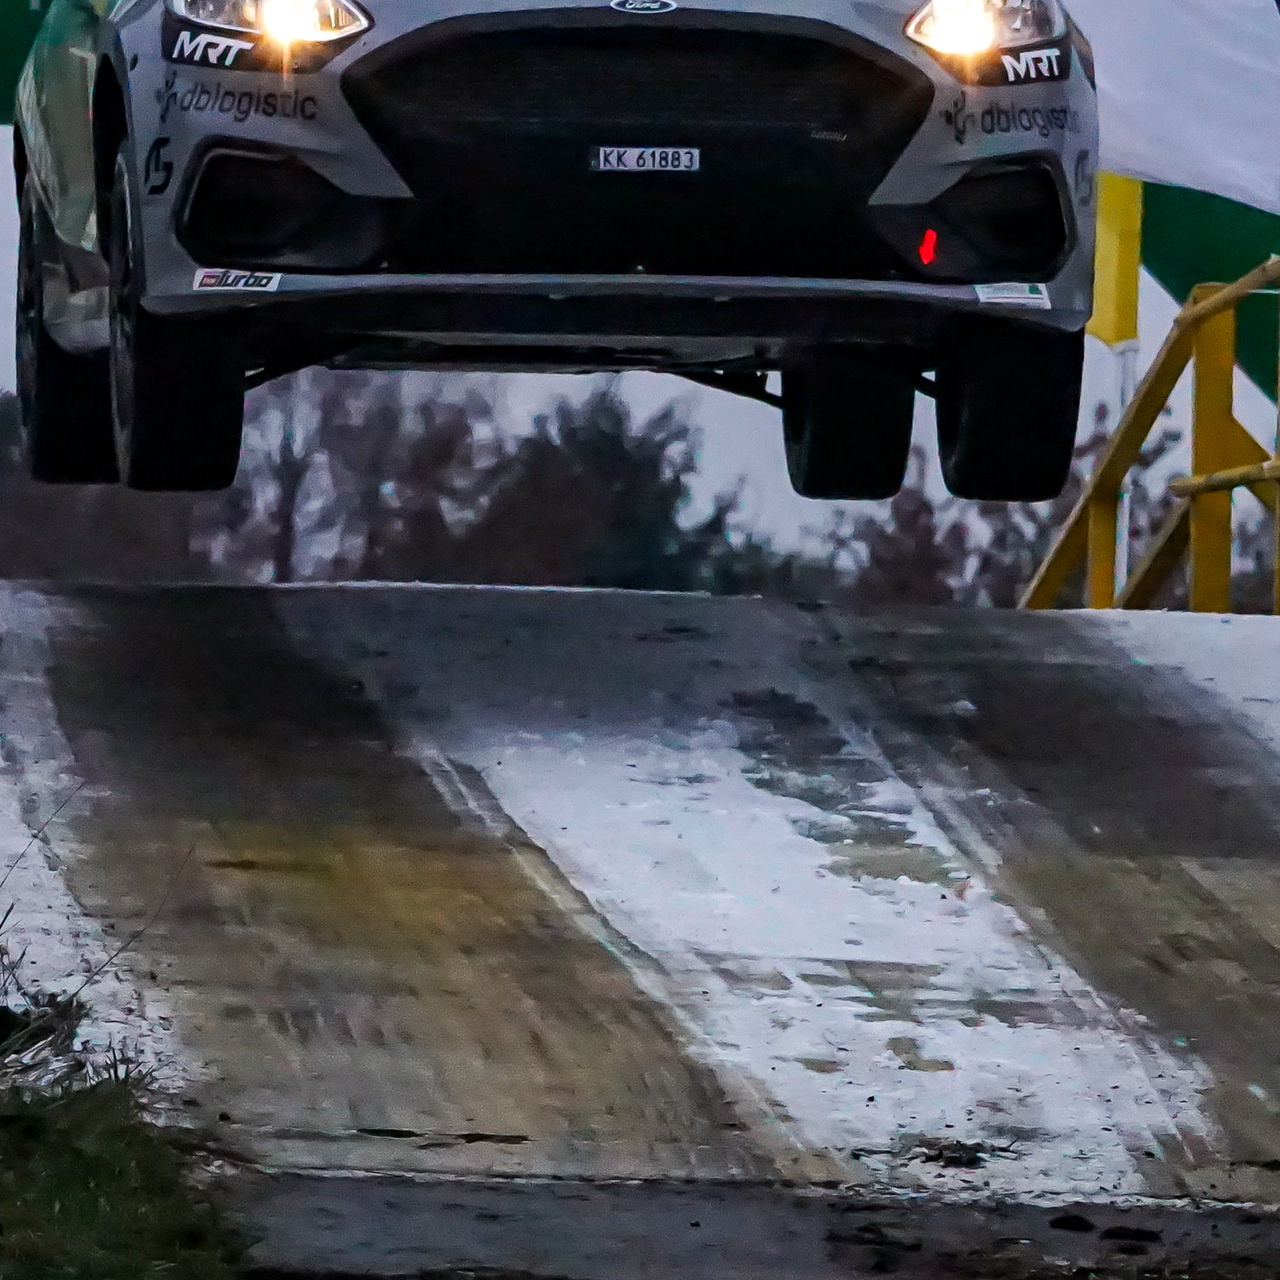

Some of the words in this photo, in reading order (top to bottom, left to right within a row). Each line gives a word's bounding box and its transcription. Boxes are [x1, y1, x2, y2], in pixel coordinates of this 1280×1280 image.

[171, 30, 255, 66] MRT
[1001, 48, 1062, 82] MRT
[602, 149, 629, 169] KK
[636, 149, 695, 170] 61883
